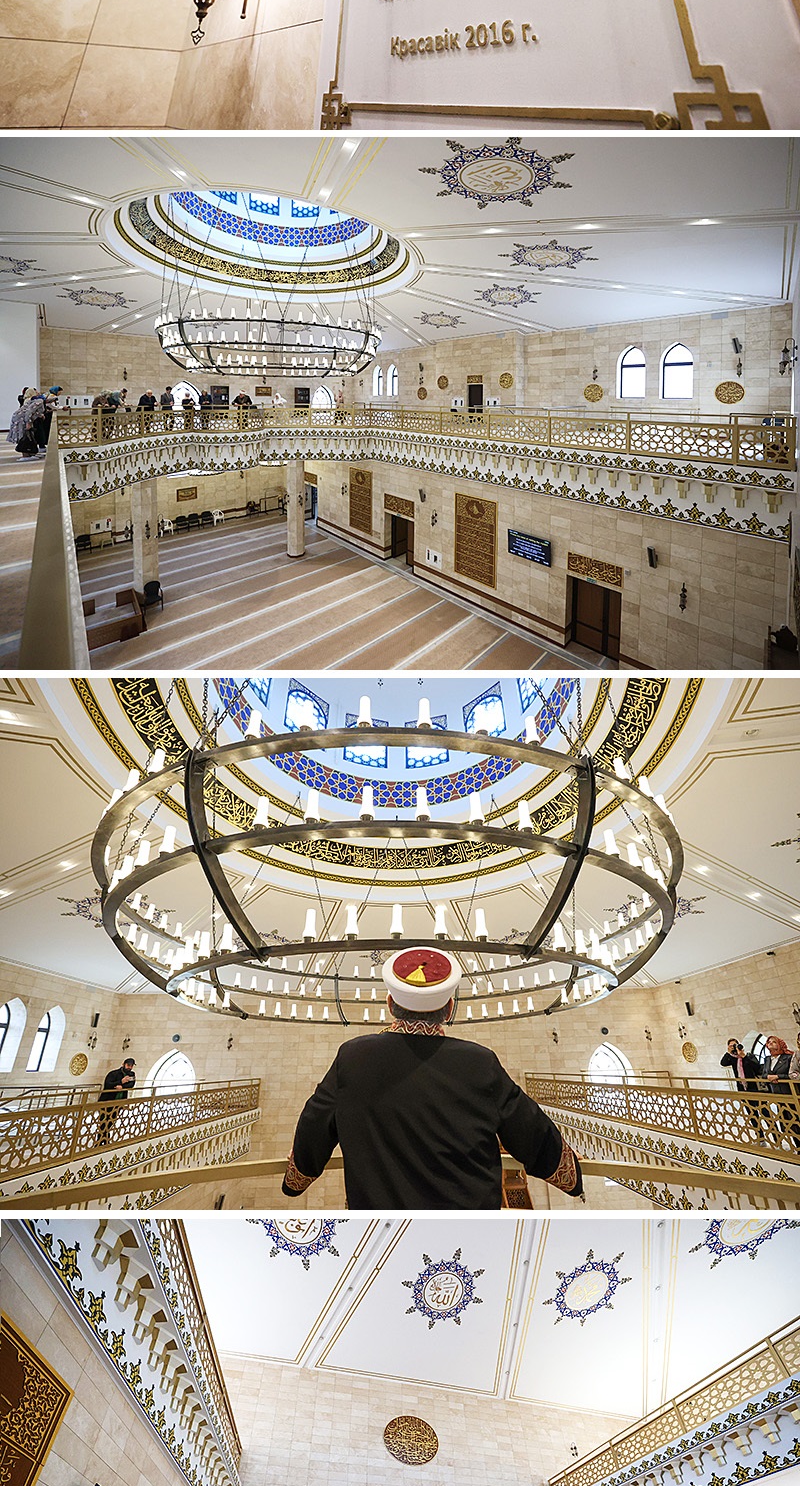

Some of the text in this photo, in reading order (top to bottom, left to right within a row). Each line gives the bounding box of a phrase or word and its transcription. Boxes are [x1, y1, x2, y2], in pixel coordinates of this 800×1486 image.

[390, 19, 538, 59] Красавік 2016 г.
